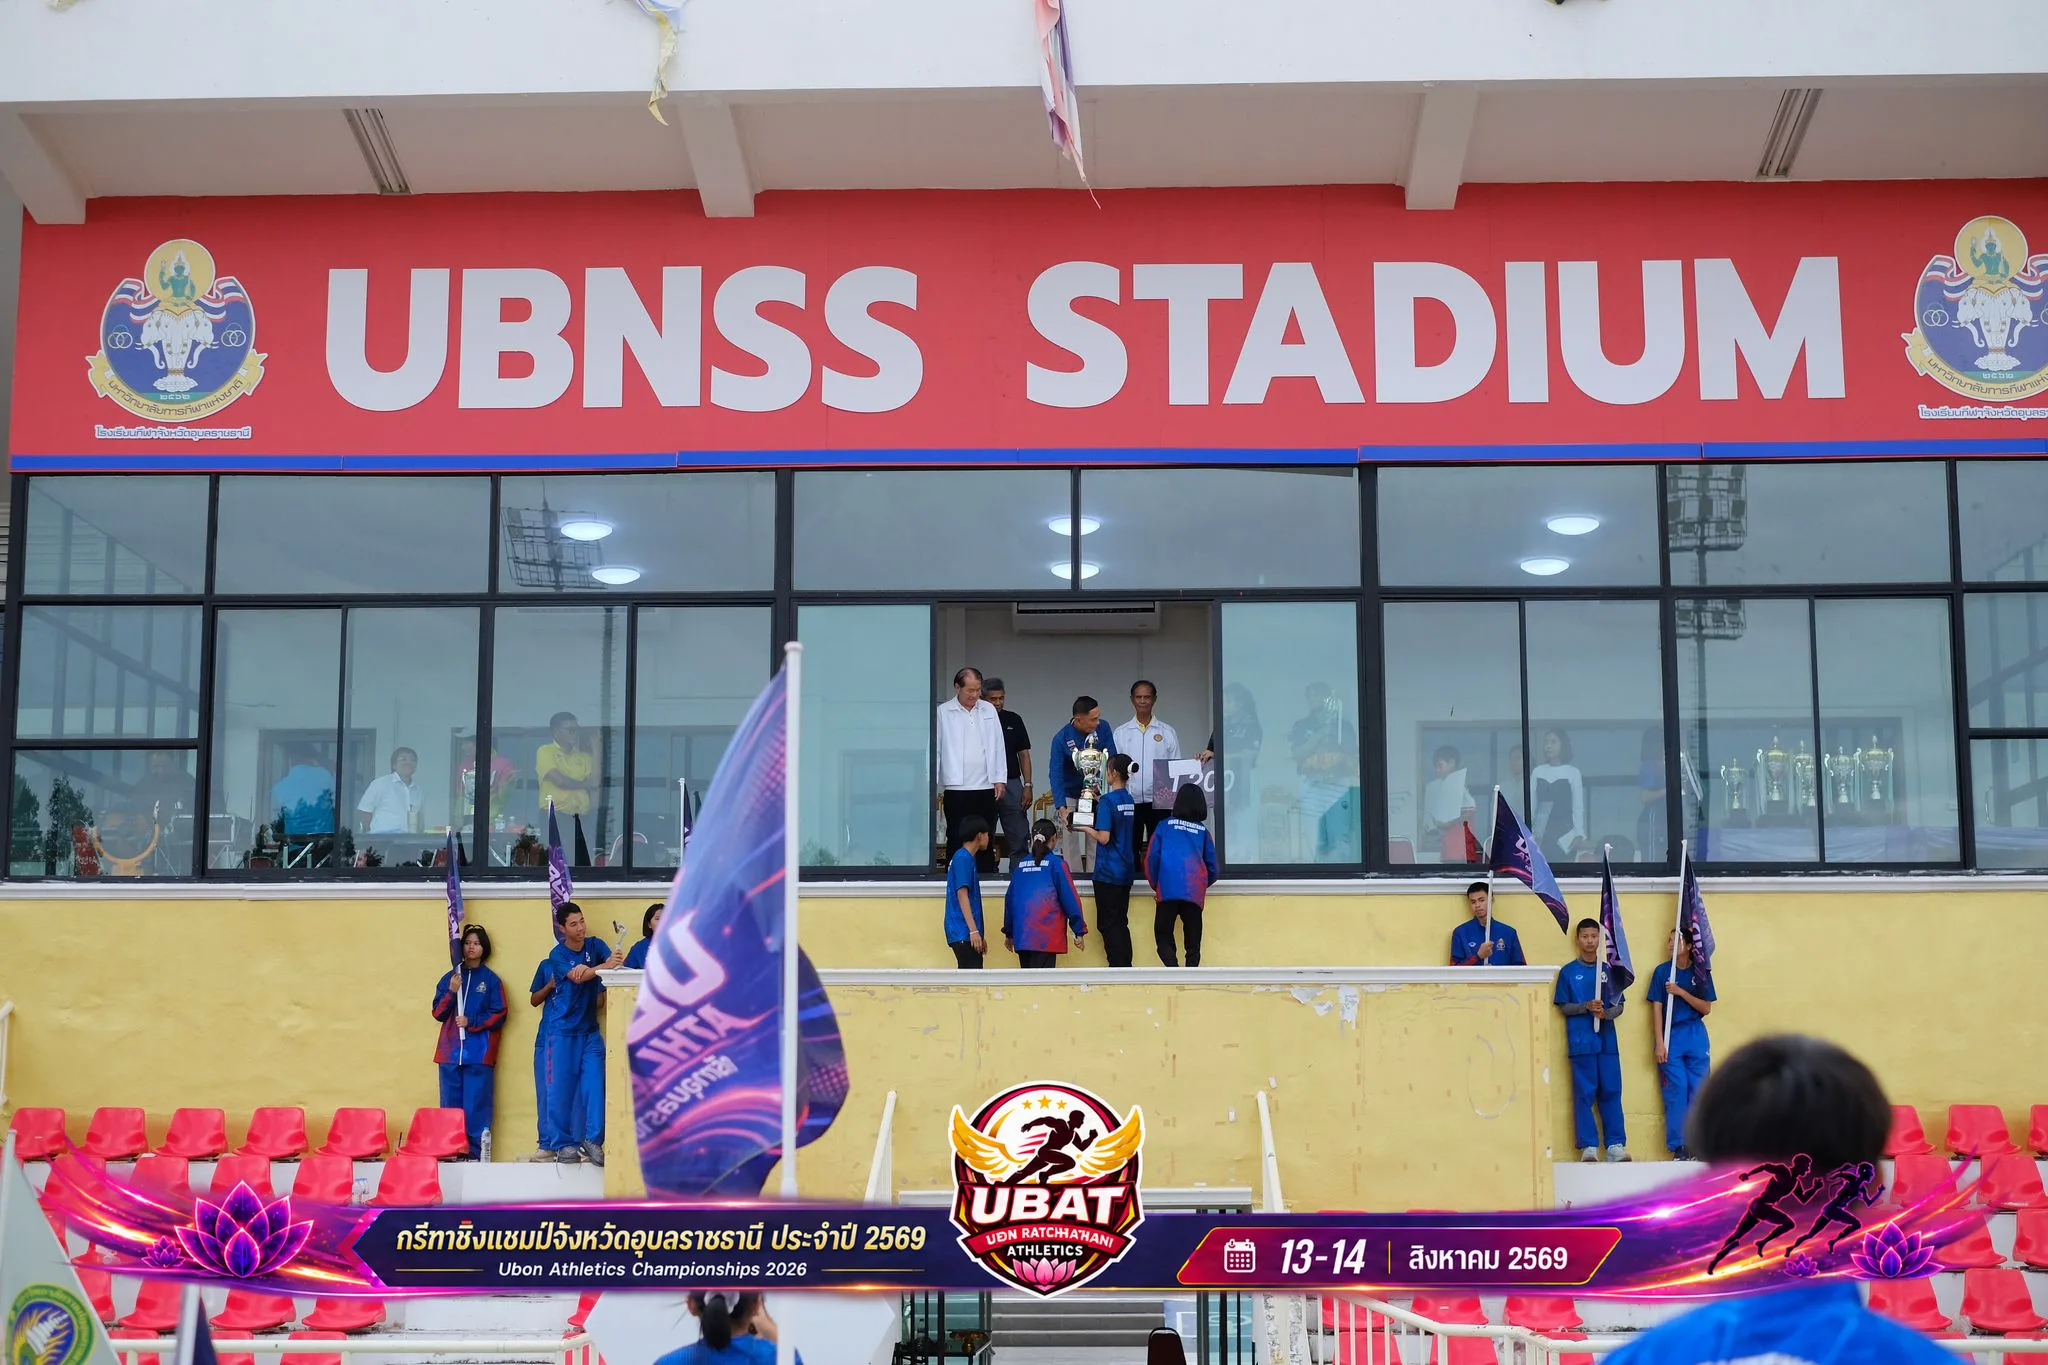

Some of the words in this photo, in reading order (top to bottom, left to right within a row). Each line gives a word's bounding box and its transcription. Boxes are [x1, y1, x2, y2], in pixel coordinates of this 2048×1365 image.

[325, 265, 924, 413] UBNSS
[1026, 256, 1845, 409] STADIUM
[1928, 358, 2048, 395] มหาวิทยาลัยการกีฬาแห่ง
